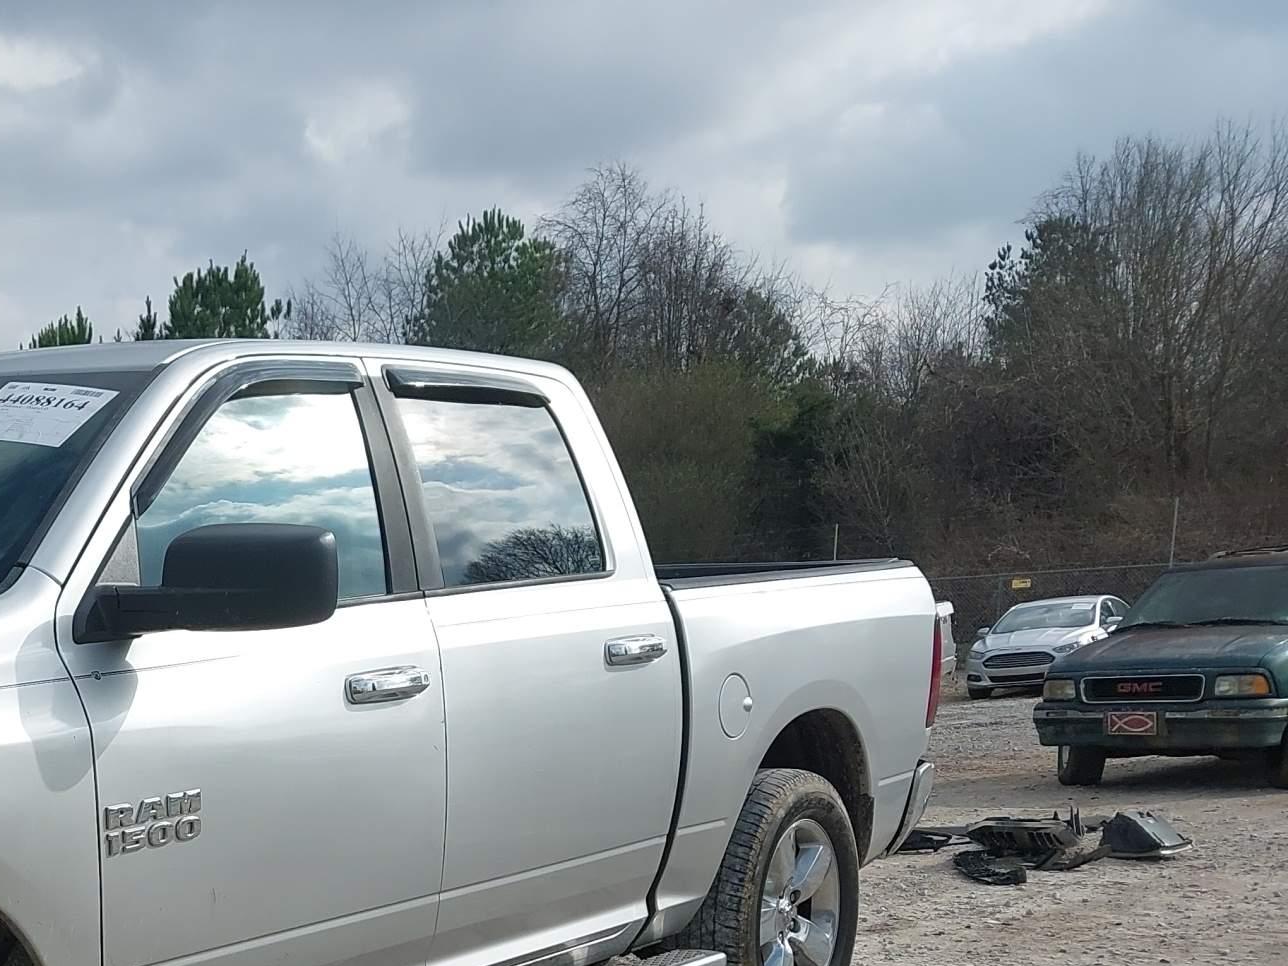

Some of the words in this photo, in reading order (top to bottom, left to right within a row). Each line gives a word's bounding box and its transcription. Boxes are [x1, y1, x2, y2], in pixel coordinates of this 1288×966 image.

[0, 393, 90, 411] 44088164
[1116, 681, 1163, 693] GMC
[103, 788, 202, 830] RAM
[104, 815, 202, 858] 1500
